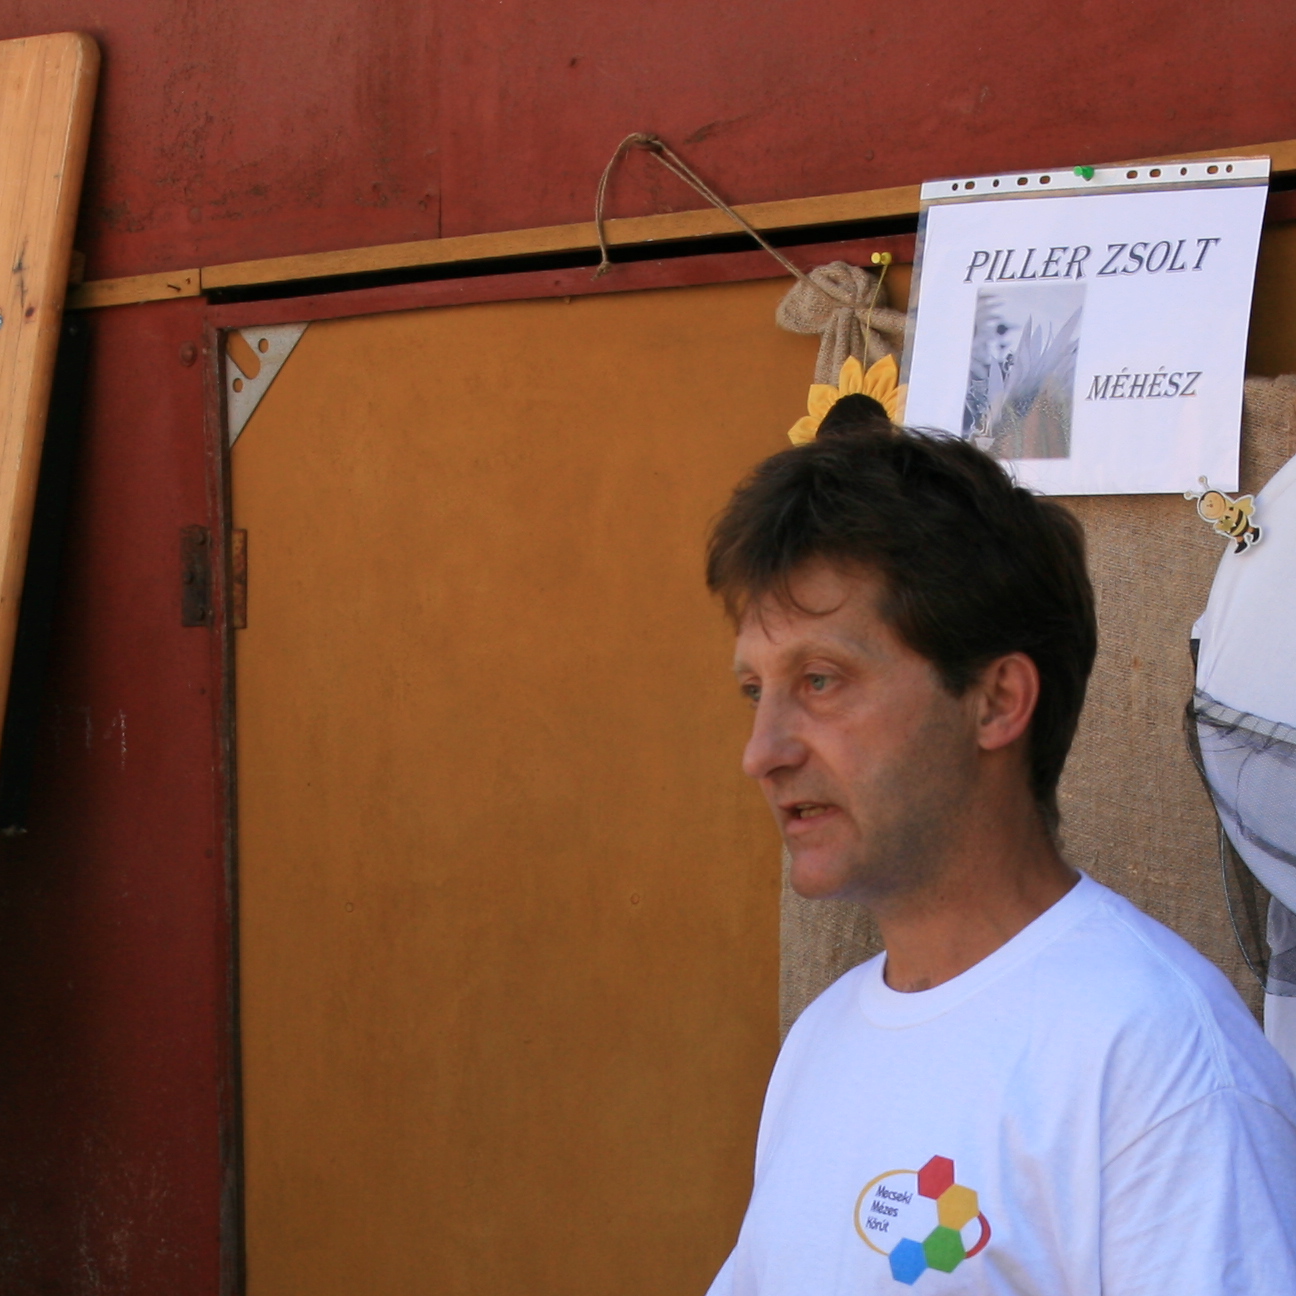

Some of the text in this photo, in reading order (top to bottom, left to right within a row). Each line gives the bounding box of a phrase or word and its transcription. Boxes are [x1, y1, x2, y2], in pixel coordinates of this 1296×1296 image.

[963, 237, 1221, 283] PILLER ZSOLT
[1086, 366, 1203, 401] MÉHÉSZ
